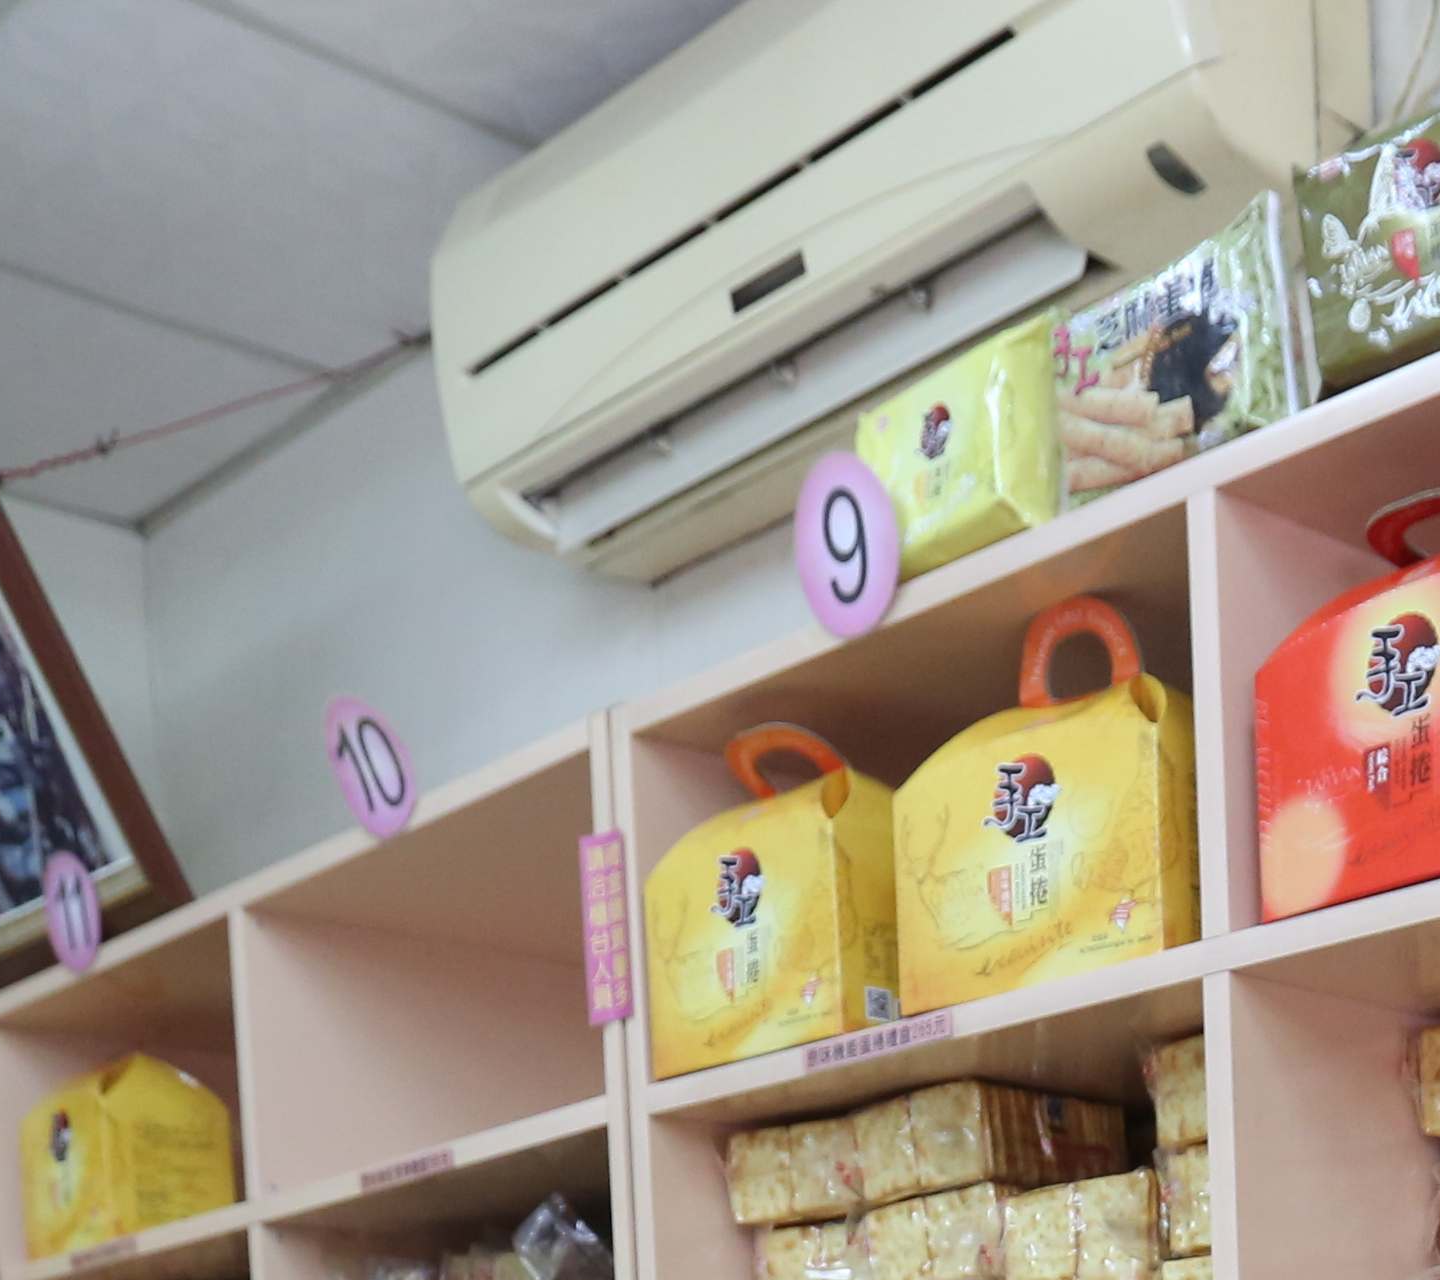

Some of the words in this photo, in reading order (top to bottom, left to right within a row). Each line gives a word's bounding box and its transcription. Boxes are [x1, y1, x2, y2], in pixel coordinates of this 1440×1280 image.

[823, 486, 868, 604] 9
[336, 716, 408, 812] 10
[58, 877, 90, 951] 11
